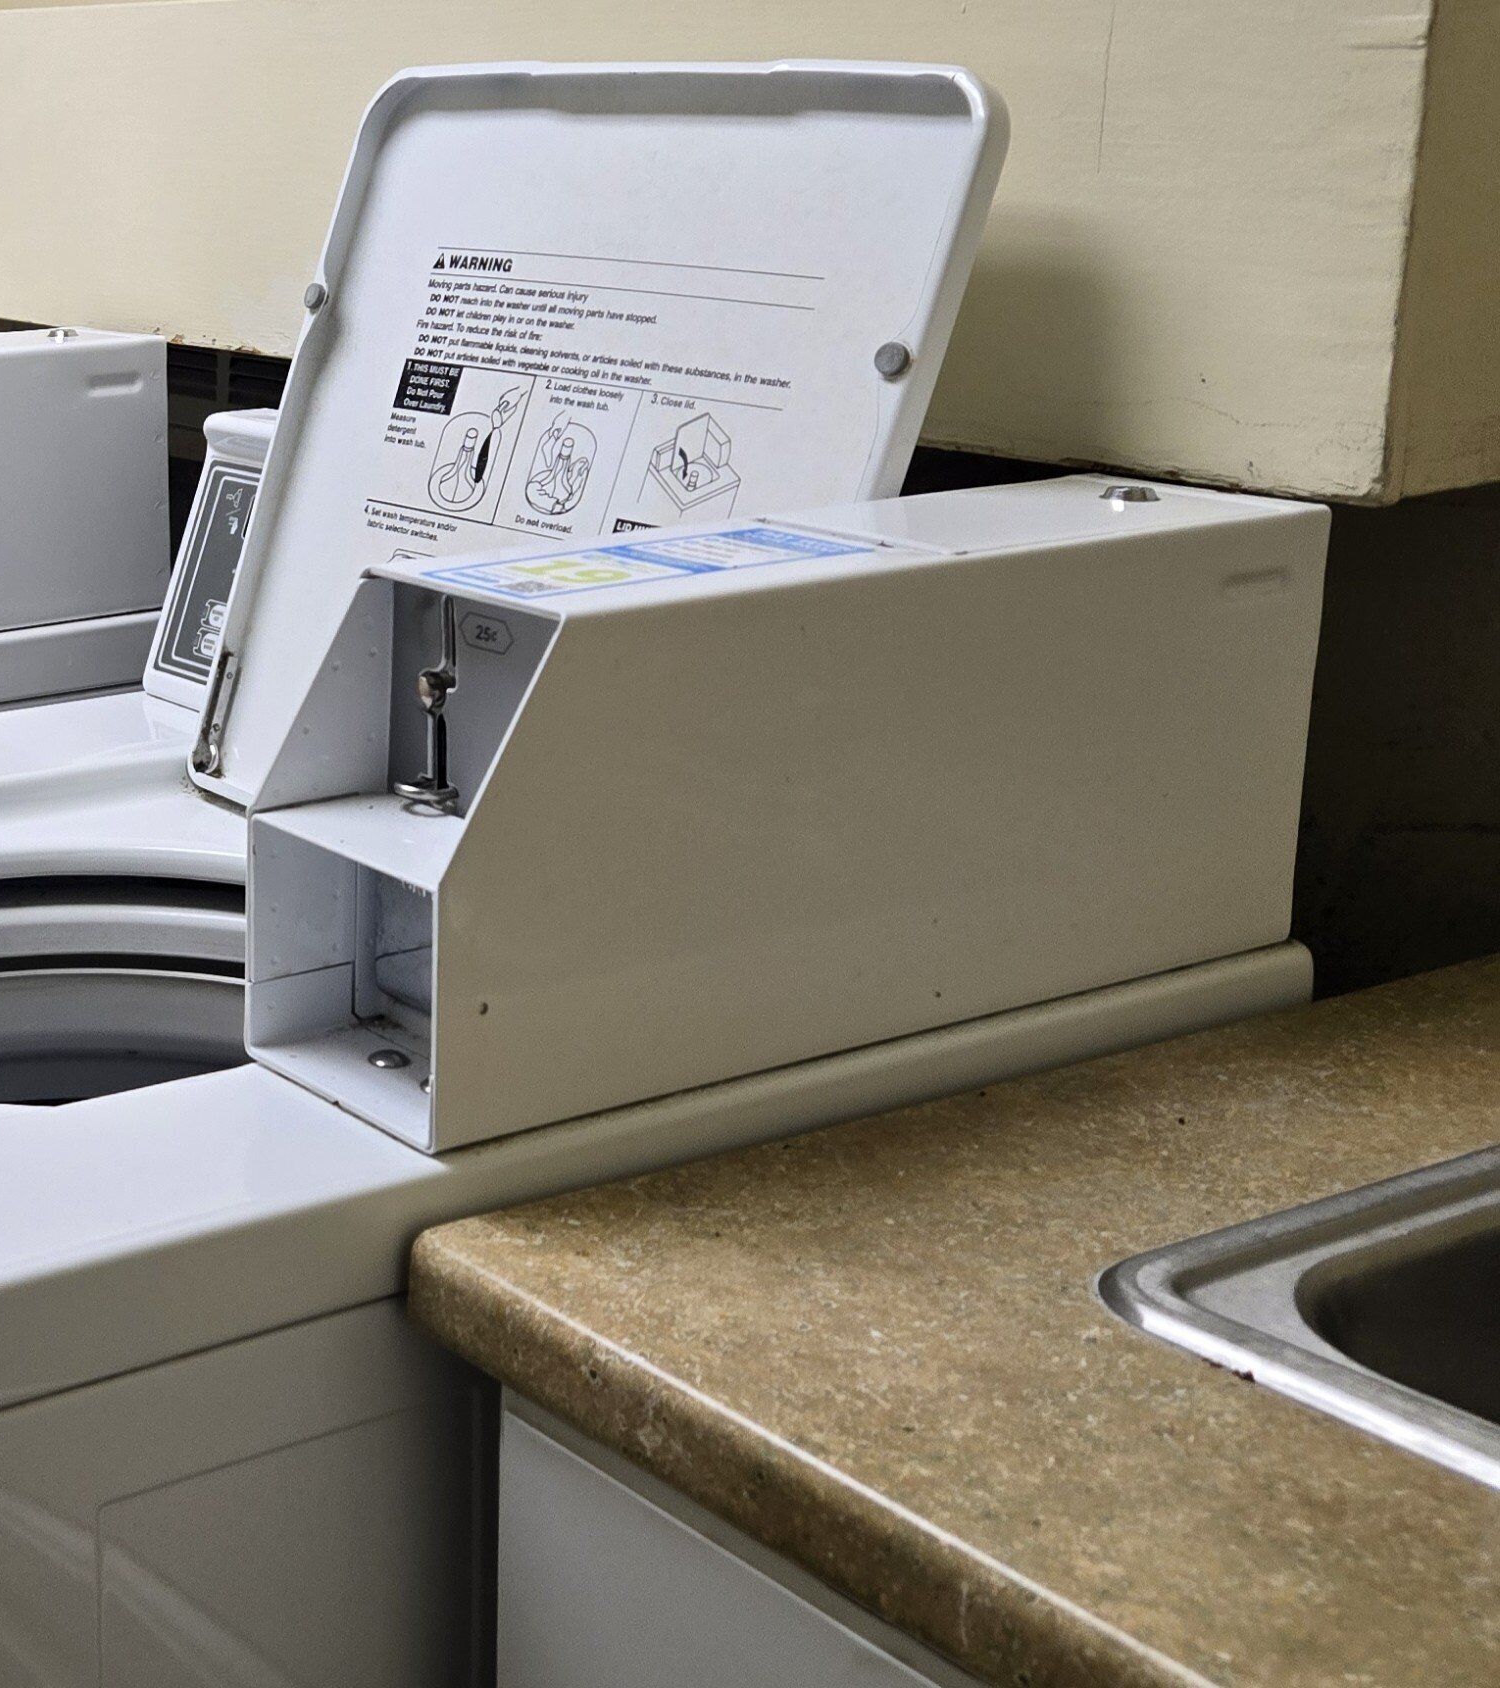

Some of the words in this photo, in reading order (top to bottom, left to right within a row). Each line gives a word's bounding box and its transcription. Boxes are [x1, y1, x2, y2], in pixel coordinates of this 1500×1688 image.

[450, 255, 513, 272] WARNING
[428, 279, 452, 292] Moving
[454, 282, 471, 292] parts
[473, 283, 497, 293] hazard.
[500, 284, 513, 294] Can
[515, 288, 536, 296] cause
[538, 288, 565, 299] serious
[566, 291, 588, 304] injury
[430, 294, 441, 302] DO
[443, 295, 460, 303] NOT
[460, 296, 478, 304] reach
[480, 298, 492, 306] into
[494, 300, 504, 308] the
[506, 301, 530, 310] washer
[532, 303, 547, 312] until
[548, 304, 557, 313] all
[558, 306, 584, 318] moving
[585, 310, 604, 319] parts
[606, 310, 624, 320] have
[625, 313, 657, 324] stopped.
[426, 307, 437, 316] DO
[438, 308, 455, 317] NOT
[456, 310, 465, 318] let
[466, 311, 491, 321] children
[493, 312, 507, 324] play
[508, 314, 515, 323] in
[536, 318, 547, 326] the
[549, 320, 575, 330] washer.
[417, 320, 429, 329] Fire
[456, 322, 465, 332] To
[466, 324, 489, 335] reduce
[492, 327, 502, 336] the
[504, 328, 517, 338] risk
[520, 330, 528, 340] of
[528, 331, 542, 342] fire:
[414, 347, 425, 356] DO
[427, 349, 443, 358] NOT
[444, 351, 455, 361] put
[456, 352, 479, 363] articles
[480, 355, 500, 365] soiled
[502, 358, 516, 367] with
[518, 360, 550, 372] vegetable
[561, 366, 588, 379] cooking
[591, 369, 600, 379] oil
[602, 370, 609, 380] in
[610, 372, 622, 381] the
[624, 374, 652, 385] washer.
[418, 334, 430, 342] DO
[431, 335, 448, 344] NOT
[448, 337, 460, 347] put
[461, 338, 494, 350] flammable
[520, 345, 548, 358] cleaning
[550, 350, 580, 362] solvents,
[582, 354, 591, 362] or
[592, 354, 618, 365] articles
[620, 358, 643, 368] soiled
[644, 361, 660, 371] with
[662, 363, 682, 374] these
[685, 366, 731, 382] substances,
[734, 372, 742, 382] in
[744, 374, 757, 384] the
[760, 376, 791, 388] washer.
[414, 363, 428, 372] THIS
[430, 365, 449, 375] MUST
[450, 367, 460, 377] BE
[410, 375, 428, 386] DONE
[430, 378, 450, 388] FIRST.
[407, 386, 416, 396] Do
[417, 387, 428, 397] Not
[428, 389, 445, 399] Pour
[554, 382, 571, 392] Load
[572, 385, 597, 396] clothes
[600, 388, 624, 402] loosely
[404, 398, 419, 408] Over
[550, 394, 562, 404] into
[564, 396, 574, 406] the
[576, 399, 594, 409] wash
[596, 402, 609, 411] tub.
[651, 393, 658, 404] 3.
[661, 396, 682, 408] Close
[684, 400, 696, 410] lid.
[391, 412, 416, 422] Measure
[388, 424, 417, 435] detergent
[384, 434, 396, 443] into
[398, 436, 413, 446] wash
[414, 438, 426, 448] tub.
[371, 507, 380, 516] Set
[382, 512, 398, 520] wash
[399, 514, 435, 528] temperature
[437, 522, 457, 532] and/or
[515, 515, 525, 524] Do
[526, 518, 540, 526] not
[541, 522, 573, 534] overload.
[616, 522, 632, 531] LID
[367, 519, 384, 530] fabric
[385, 524, 409, 536] selector
[410, 530, 438, 541] switches.
[476, 624, 497, 642] 25¢
